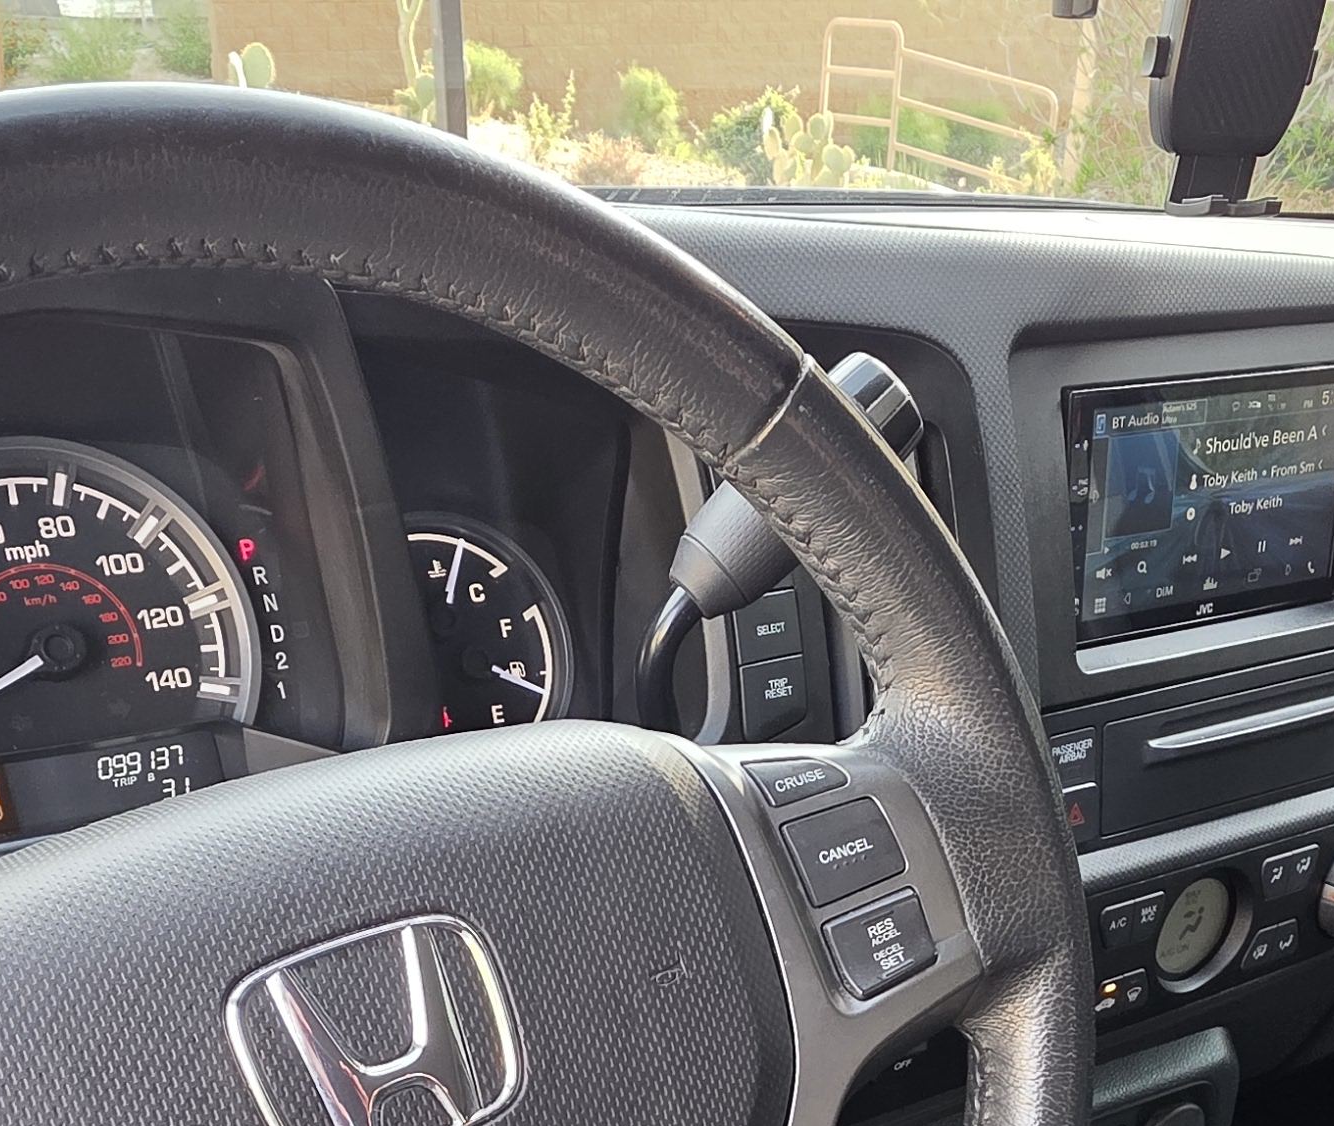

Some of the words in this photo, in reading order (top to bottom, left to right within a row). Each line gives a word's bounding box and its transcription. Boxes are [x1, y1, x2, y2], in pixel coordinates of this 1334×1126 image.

[1112, 415, 1126, 429] BT
[1127, 412, 1159, 428] Audio
[1205, 433, 1269, 454] Should've
[1272, 428, 1305, 446] Been
[1307, 425, 1318, 441] A
[1202, 474, 1228, 488] Toby
[1231, 470, 1258, 484] Keith
[1271, 464, 1298, 478] From
[1299, 460, 1315, 473] Sm
[1229, 501, 1253, 515] Toby
[1256, 495, 1283, 511] Keith
[37, 515, 75, 539] 80
[4, 539, 50, 563] mph
[239, 539, 255, 561] P
[95, 552, 144, 576] 100
[9, 578, 30, 590] 100
[34, 573, 55, 585] 120
[252, 566, 268, 585] R
[59, 580, 80, 592] 140
[468, 583, 485, 602] C
[1155, 585, 1174, 598] DIM
[23, 594, 58, 607] km/h
[82, 593, 102, 605] 160
[262, 593, 278, 612] N
[99, 612, 119, 623] 180
[137, 606, 184, 630] 120
[1196, 602, 1213, 616] JVC
[270, 624, 284, 643] D
[499, 618, 512, 638] F
[756, 622, 785, 636] SELECT
[107, 633, 130, 645] 200
[110, 656, 133, 667] 220
[275, 652, 289, 670] 2
[144, 667, 192, 692] 140
[768, 677, 788, 689] TRIP
[276, 682, 286, 699] 1
[765, 685, 793, 699] RESET
[491, 704, 505, 724] E
[1052, 738, 1093, 757] PASSENGER
[1059, 749, 1086, 764] AIRBAG
[97, 744, 184, 780] 099137
[113, 775, 138, 788] TRIP
[147, 772, 156, 782] B
[774, 768, 826, 793] CRUISE
[818, 837, 874, 865] CANCEL
[867, 917, 895, 938] RES
[1109, 917, 1127, 931] A/C
[871, 928, 902, 947] ACCEL
[873, 943, 905, 961] DECEL
[880, 950, 905, 970] SET
